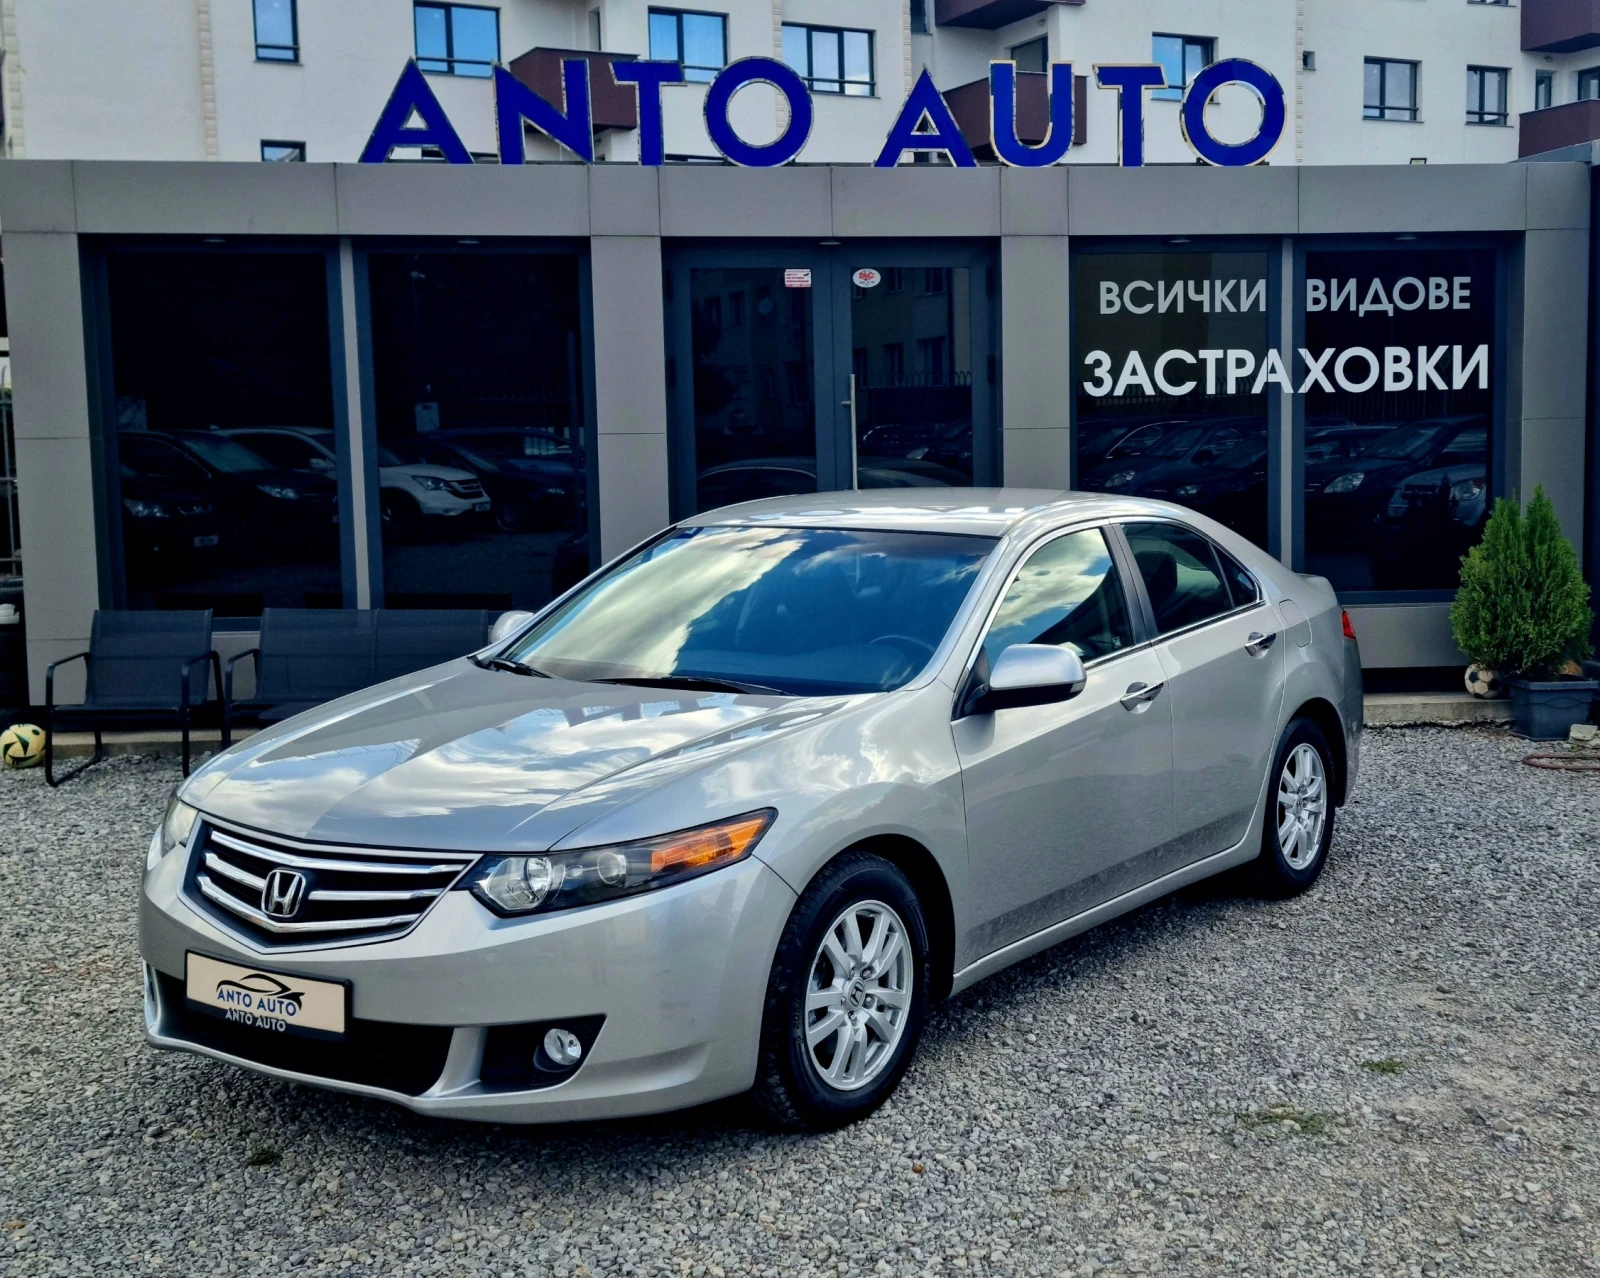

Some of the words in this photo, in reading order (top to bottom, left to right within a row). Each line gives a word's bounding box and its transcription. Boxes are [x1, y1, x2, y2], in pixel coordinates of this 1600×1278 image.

[358, 56, 815, 167] ANTO
[872, 57, 1288, 167] AUTO
[1099, 279, 1267, 315] ВСИЧКИ
[1306, 276, 1472, 318] ВИДОВЕ
[1083, 344, 1490, 397] ЗАСТРАХОВКИ
[217, 988, 252, 1008] ANTO
[257, 998, 297, 1016] AUTO
[226, 1009, 253, 1025] ANTO
[256, 1017, 286, 1032] AUTO
